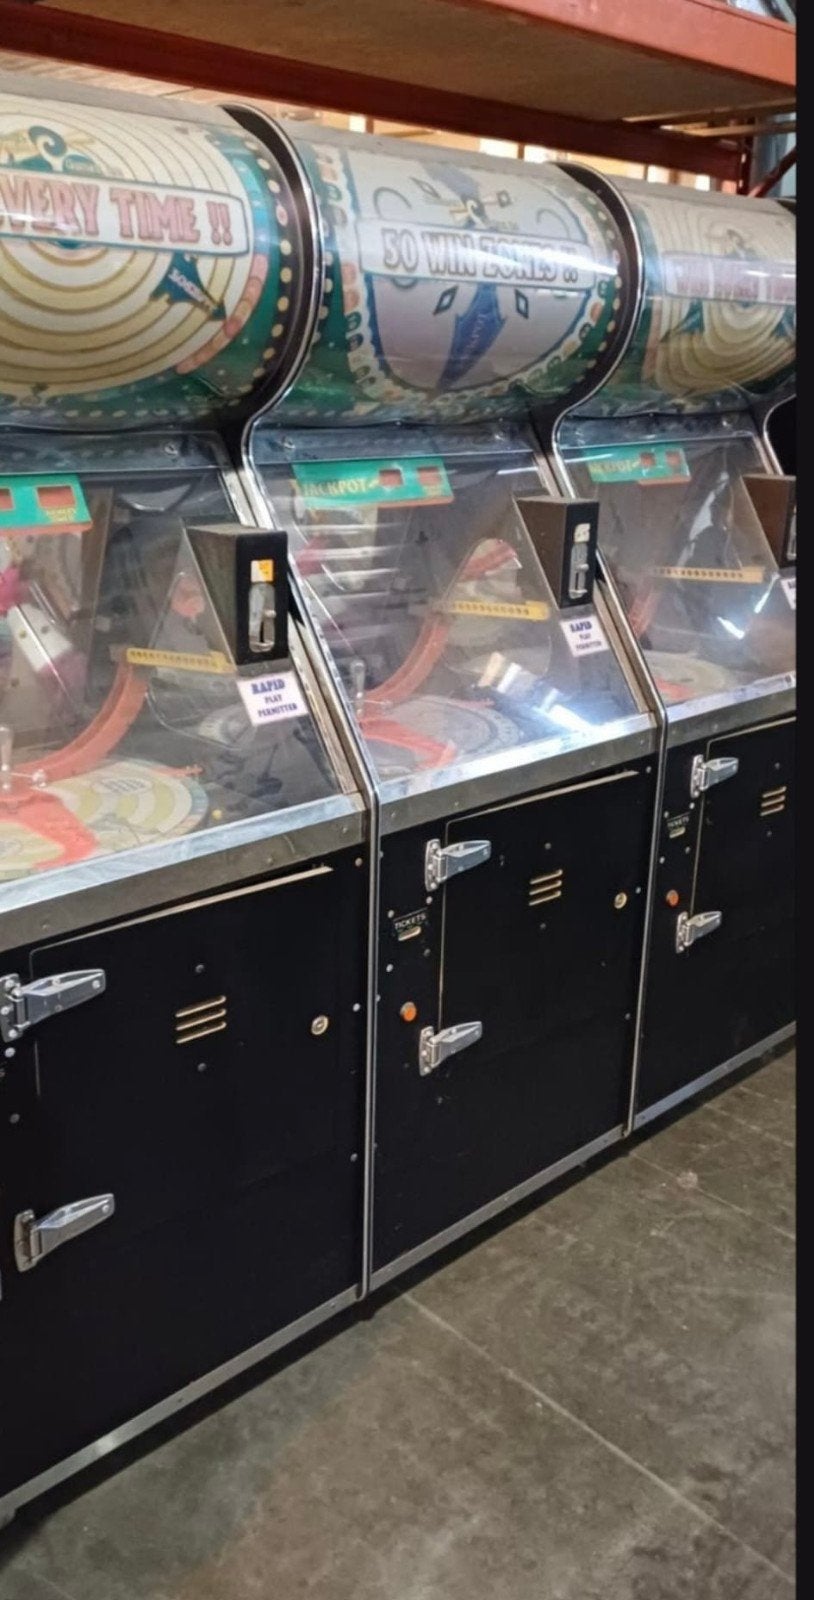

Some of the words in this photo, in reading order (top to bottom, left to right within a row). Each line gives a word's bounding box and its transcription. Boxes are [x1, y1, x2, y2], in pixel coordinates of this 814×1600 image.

[0, 174, 99, 236] VERY
[109, 186, 200, 244] TIME
[381, 228, 419, 273] 50
[421, 231, 477, 278] WIN
[301, 478, 368, 497] JACKPOT
[251, 679, 286, 695] RAPID
[265, 694, 283, 704] PLAY
[394, 913, 427, 930] TICKETS
